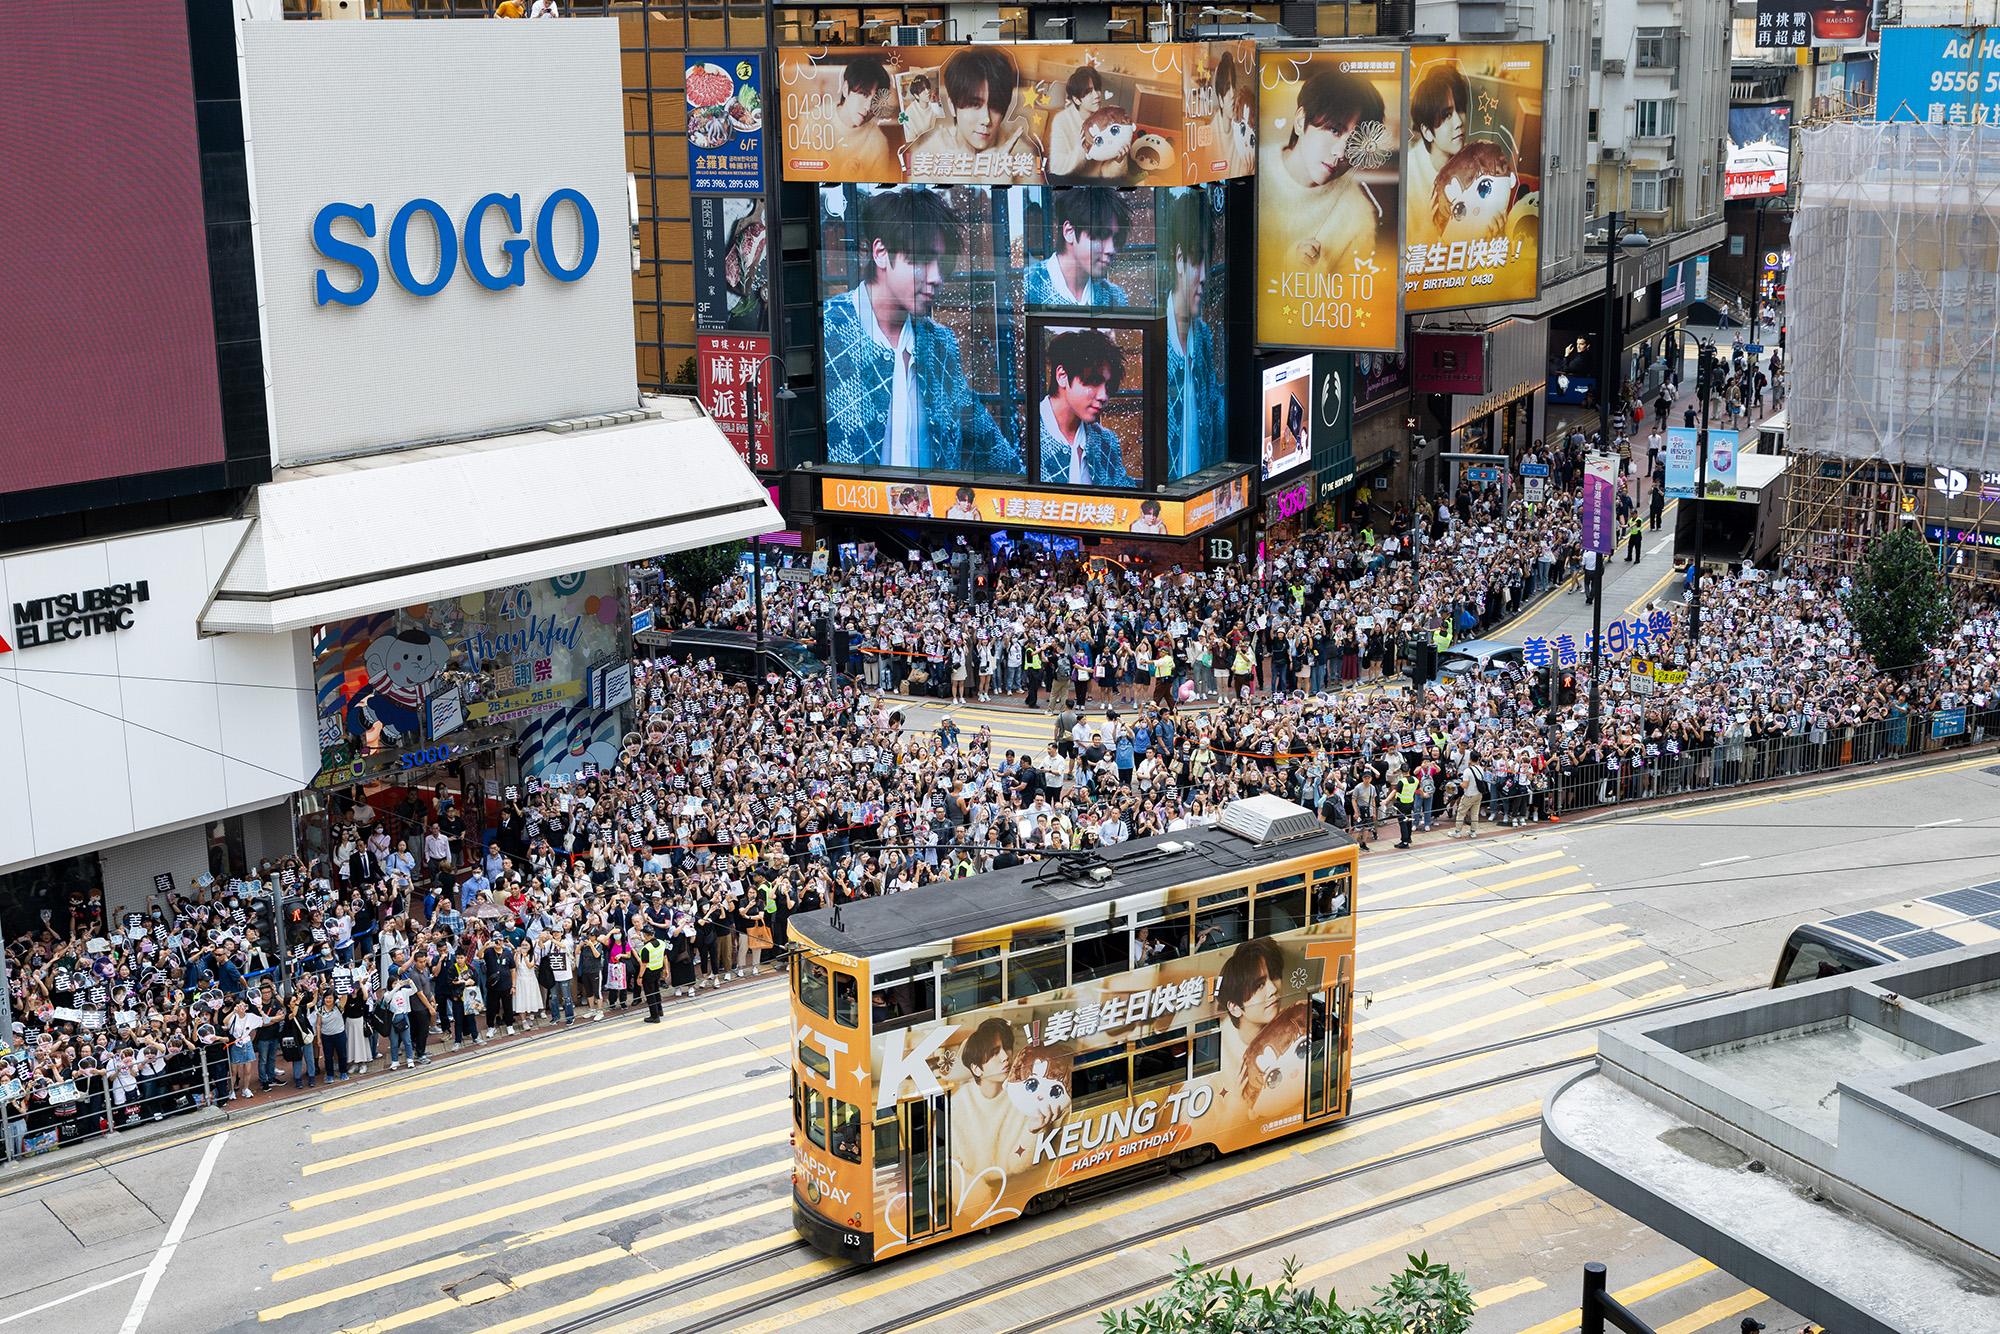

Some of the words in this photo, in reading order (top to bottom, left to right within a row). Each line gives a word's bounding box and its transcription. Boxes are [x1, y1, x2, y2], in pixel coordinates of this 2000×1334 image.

[1942, 39, 1971, 60] Ad
[1930, 71, 1979, 92] 9556
[787, 93, 834, 121] 0430
[740, 138, 758, 151] 6/F
[788, 123, 835, 150] 0430
[313, 187, 601, 307] SOGO
[1281, 272, 1342, 299] KEUNG
[1349, 273, 1373, 300] TO
[1423, 277, 1467, 291] BIRTHDAY
[1470, 273, 1494, 286] 0430
[698, 302, 711, 313] 3F
[1301, 302, 1352, 328] 0430
[738, 340, 756, 351] 4/F
[711, 355, 762, 386] 麻辣
[836, 483, 878, 509] 0430
[13, 580, 150, 625] MITSUBISHI
[15, 607, 135, 650] ELECTRIC
[453, 613, 584, 673] Thankful
[402, 743, 450, 771] SOGO
[877, 1024, 961, 1111] K
[1031, 1099, 1158, 1165] KEUNG
[1165, 1085, 1213, 1125] TO
[1071, 1149, 1113, 1173] HAPPY
[1117, 1128, 1179, 1159] BIRTHDAY
[843, 1233, 861, 1246] 153
